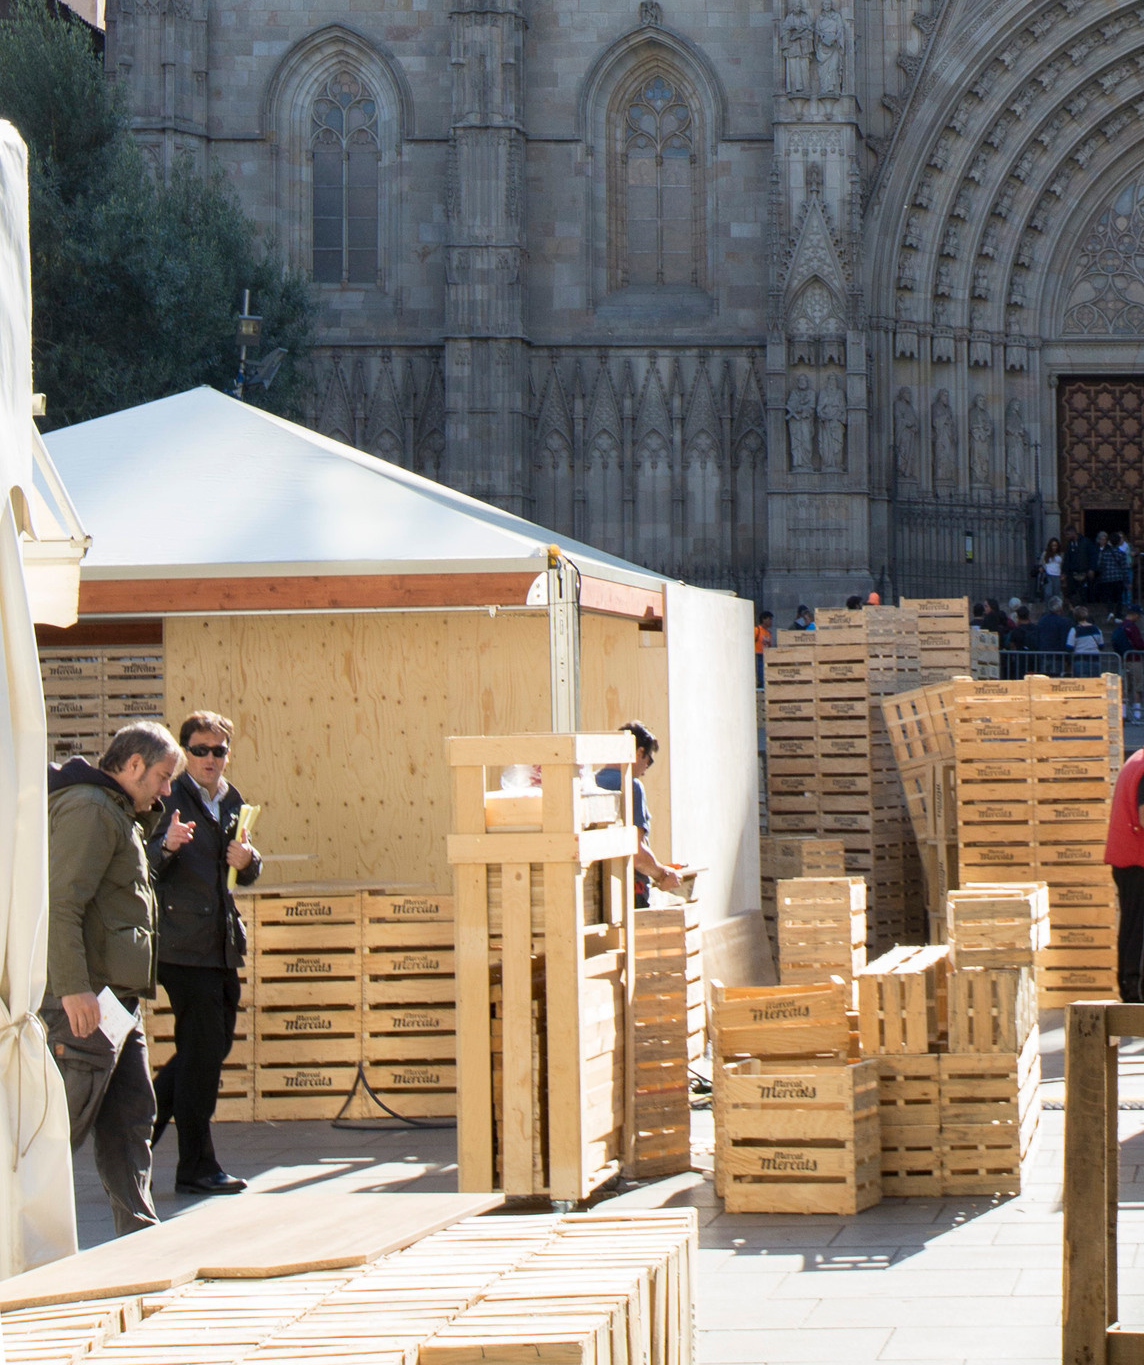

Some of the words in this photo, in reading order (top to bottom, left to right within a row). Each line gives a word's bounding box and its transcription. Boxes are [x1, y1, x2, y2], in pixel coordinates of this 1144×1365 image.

[283, 905, 332, 916] Mercats
[391, 903, 439, 914] Mercats
[284, 962, 332, 973] Mercats
[391, 959, 439, 970] Mercats
[751, 1005, 810, 1021] Mercats
[283, 1019, 332, 1030] Mercats
[391, 1017, 440, 1027] Mercats
[283, 1076, 332, 1087] Mercats
[391, 1073, 440, 1084] Mercats
[757, 1085, 816, 1099] Mercats
[775, 1152, 803, 1160] Mercat
[758, 1156, 817, 1171] Mercats
